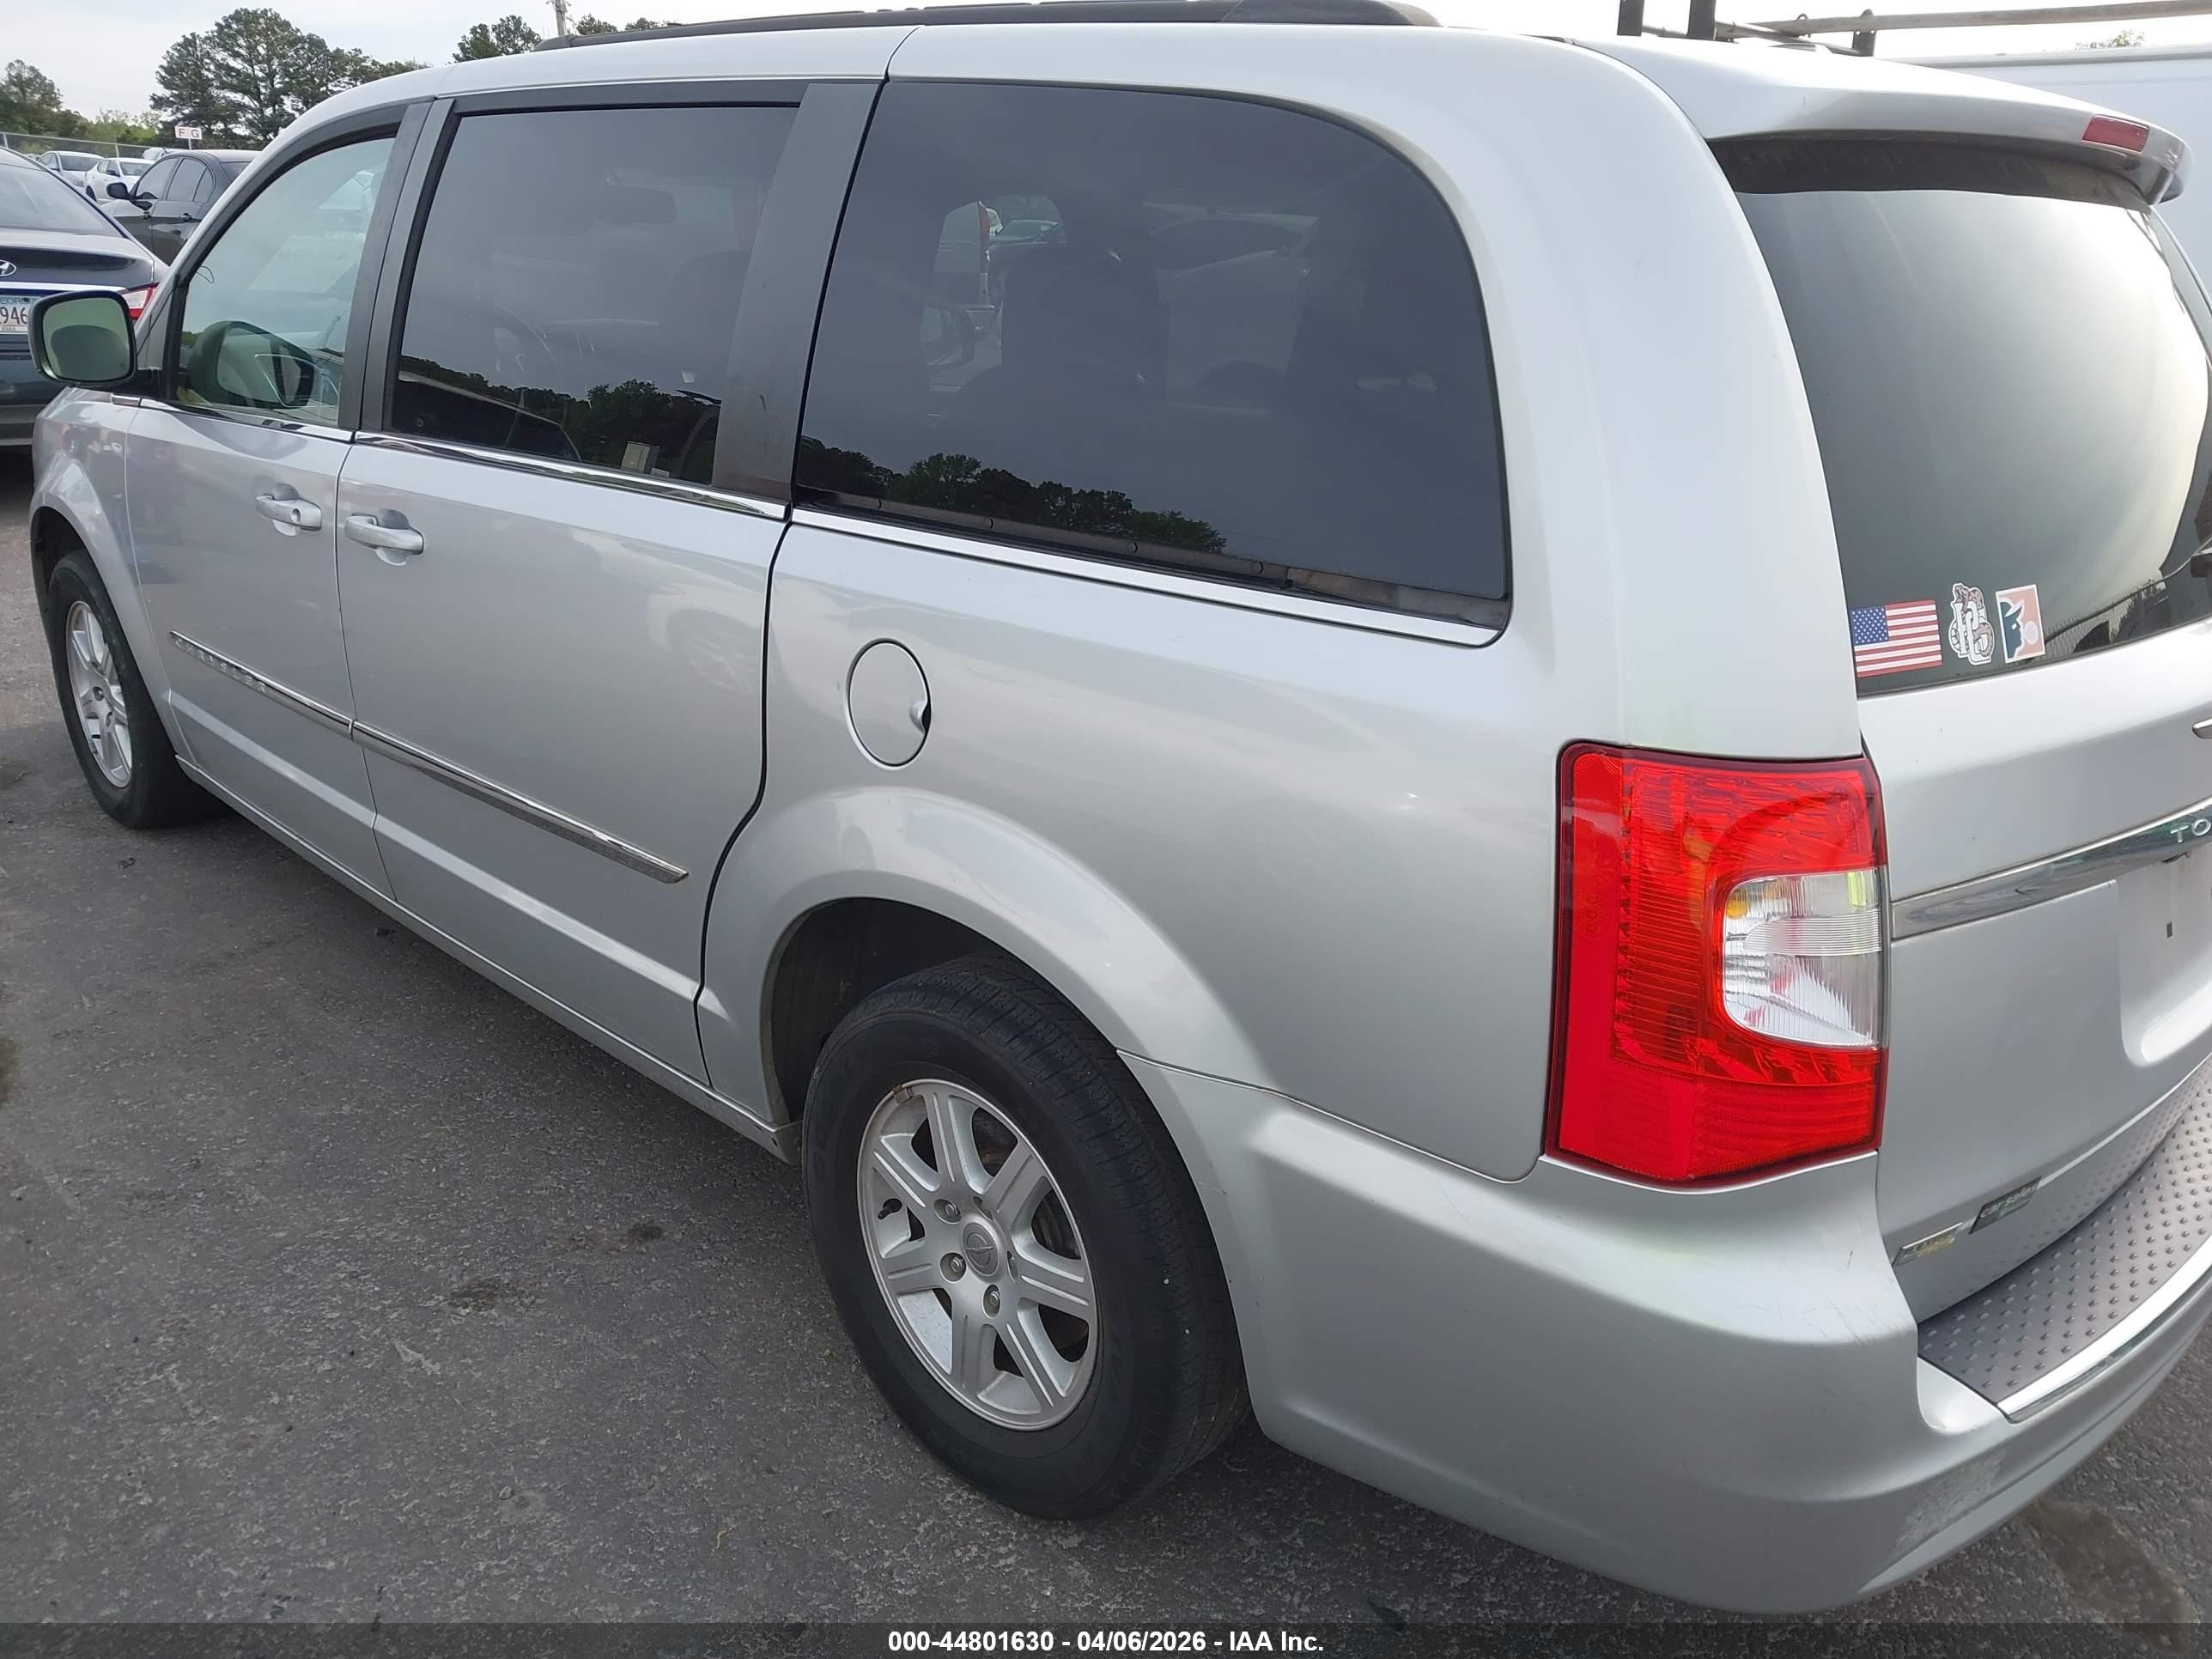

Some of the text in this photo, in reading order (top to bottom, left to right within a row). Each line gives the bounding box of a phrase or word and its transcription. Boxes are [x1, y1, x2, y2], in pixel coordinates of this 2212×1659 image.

[178, 128, 200, 138] F G
[0, 307, 28, 325] 946
[174, 637, 267, 694] CHRYSLER
[2169, 817, 2212, 844] TO
